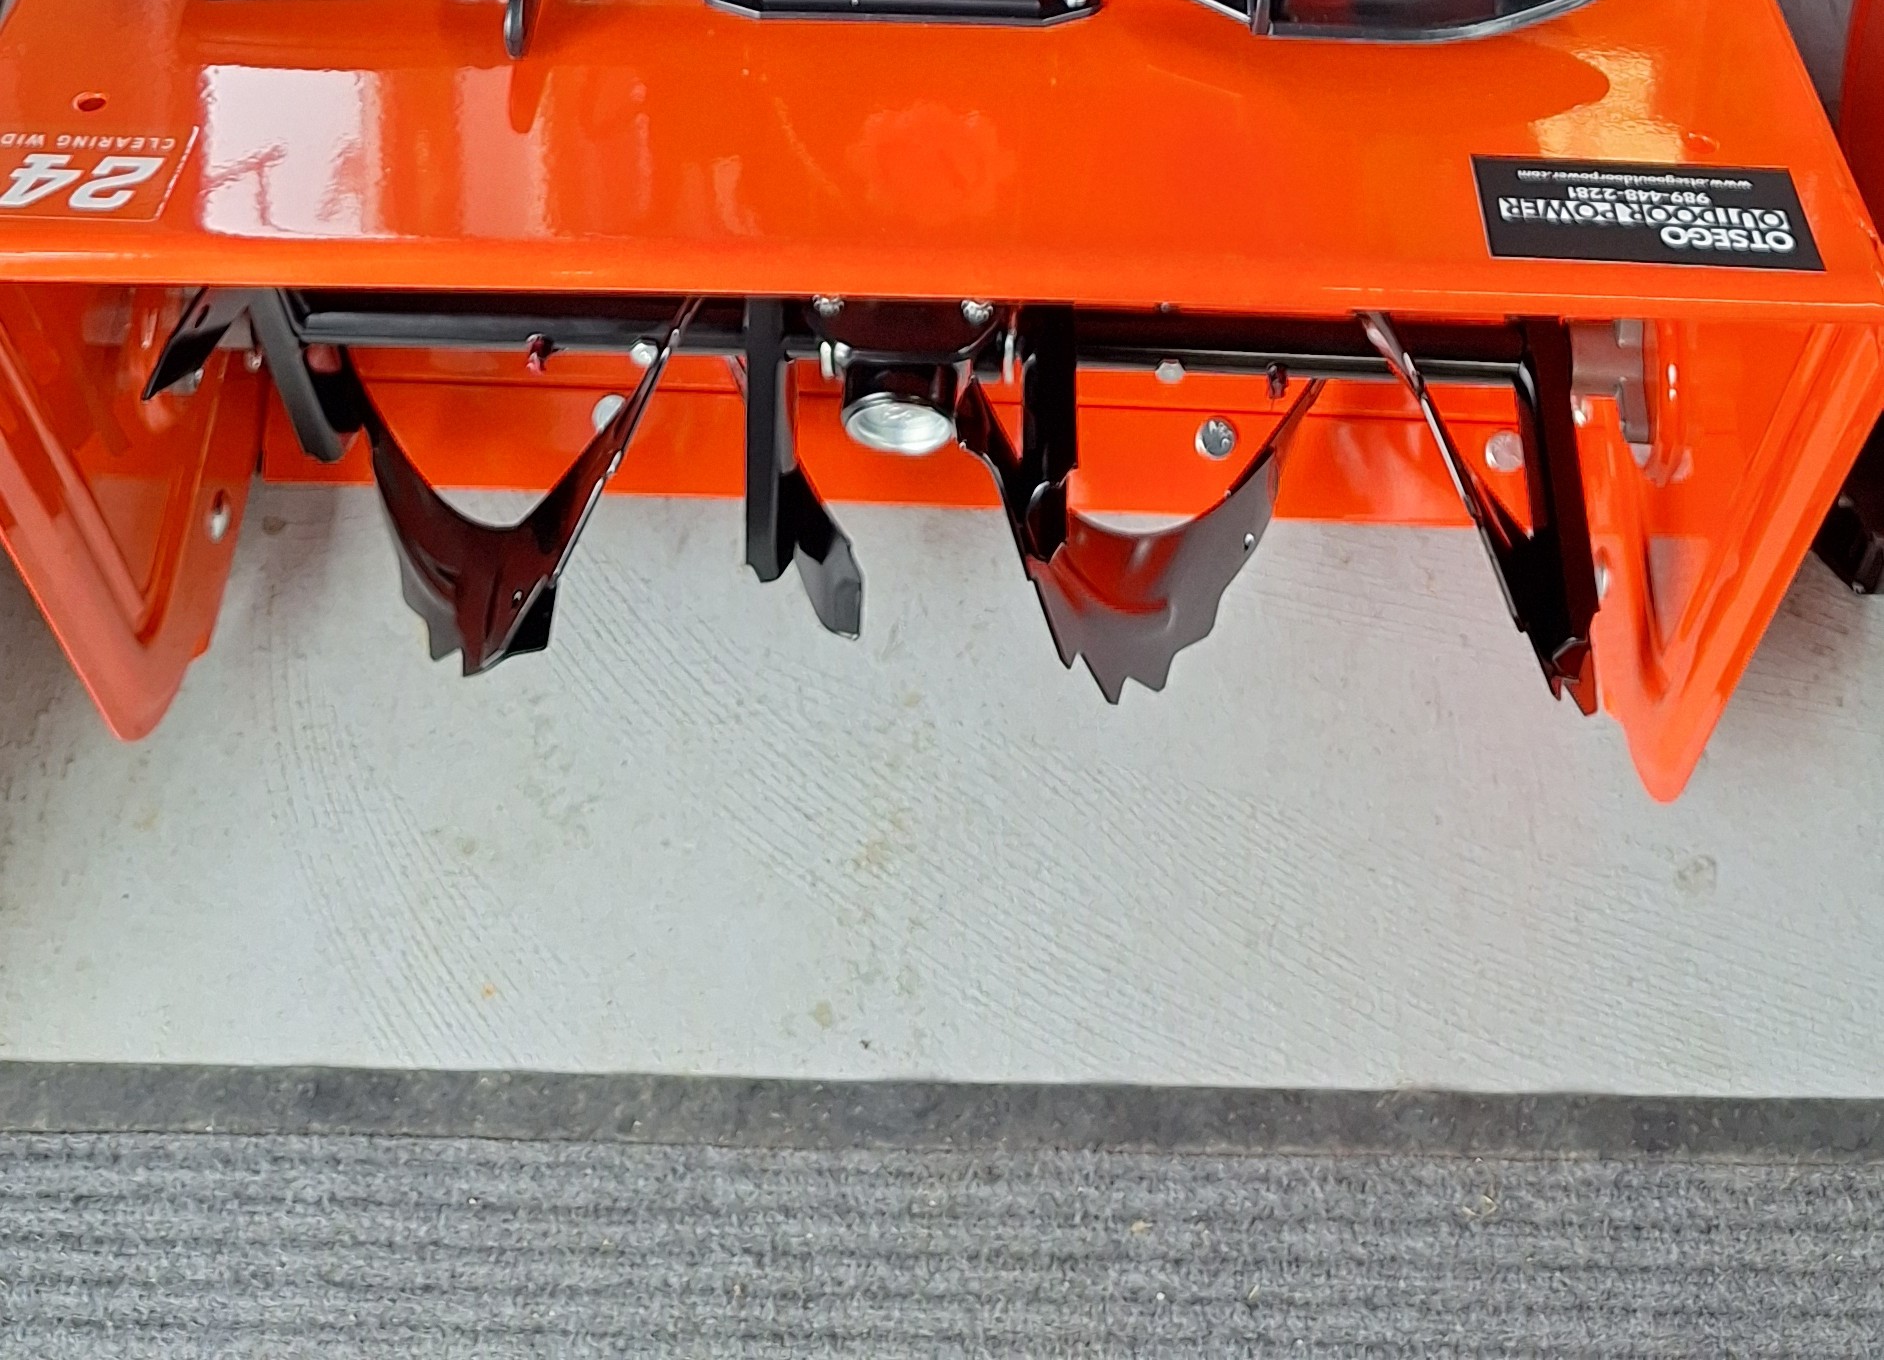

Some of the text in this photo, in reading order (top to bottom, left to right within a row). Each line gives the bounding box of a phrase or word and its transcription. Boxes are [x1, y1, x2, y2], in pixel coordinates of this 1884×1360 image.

[56, 134, 177, 151] CLEARING
[1517, 169, 1753, 190] www.otsegooutdoorpower.com
[1567, 186, 1712, 206] 989-448-2281
[1499, 197, 1791, 231] OUTDOOR POWER
[1660, 225, 1797, 253] OTSEGO
